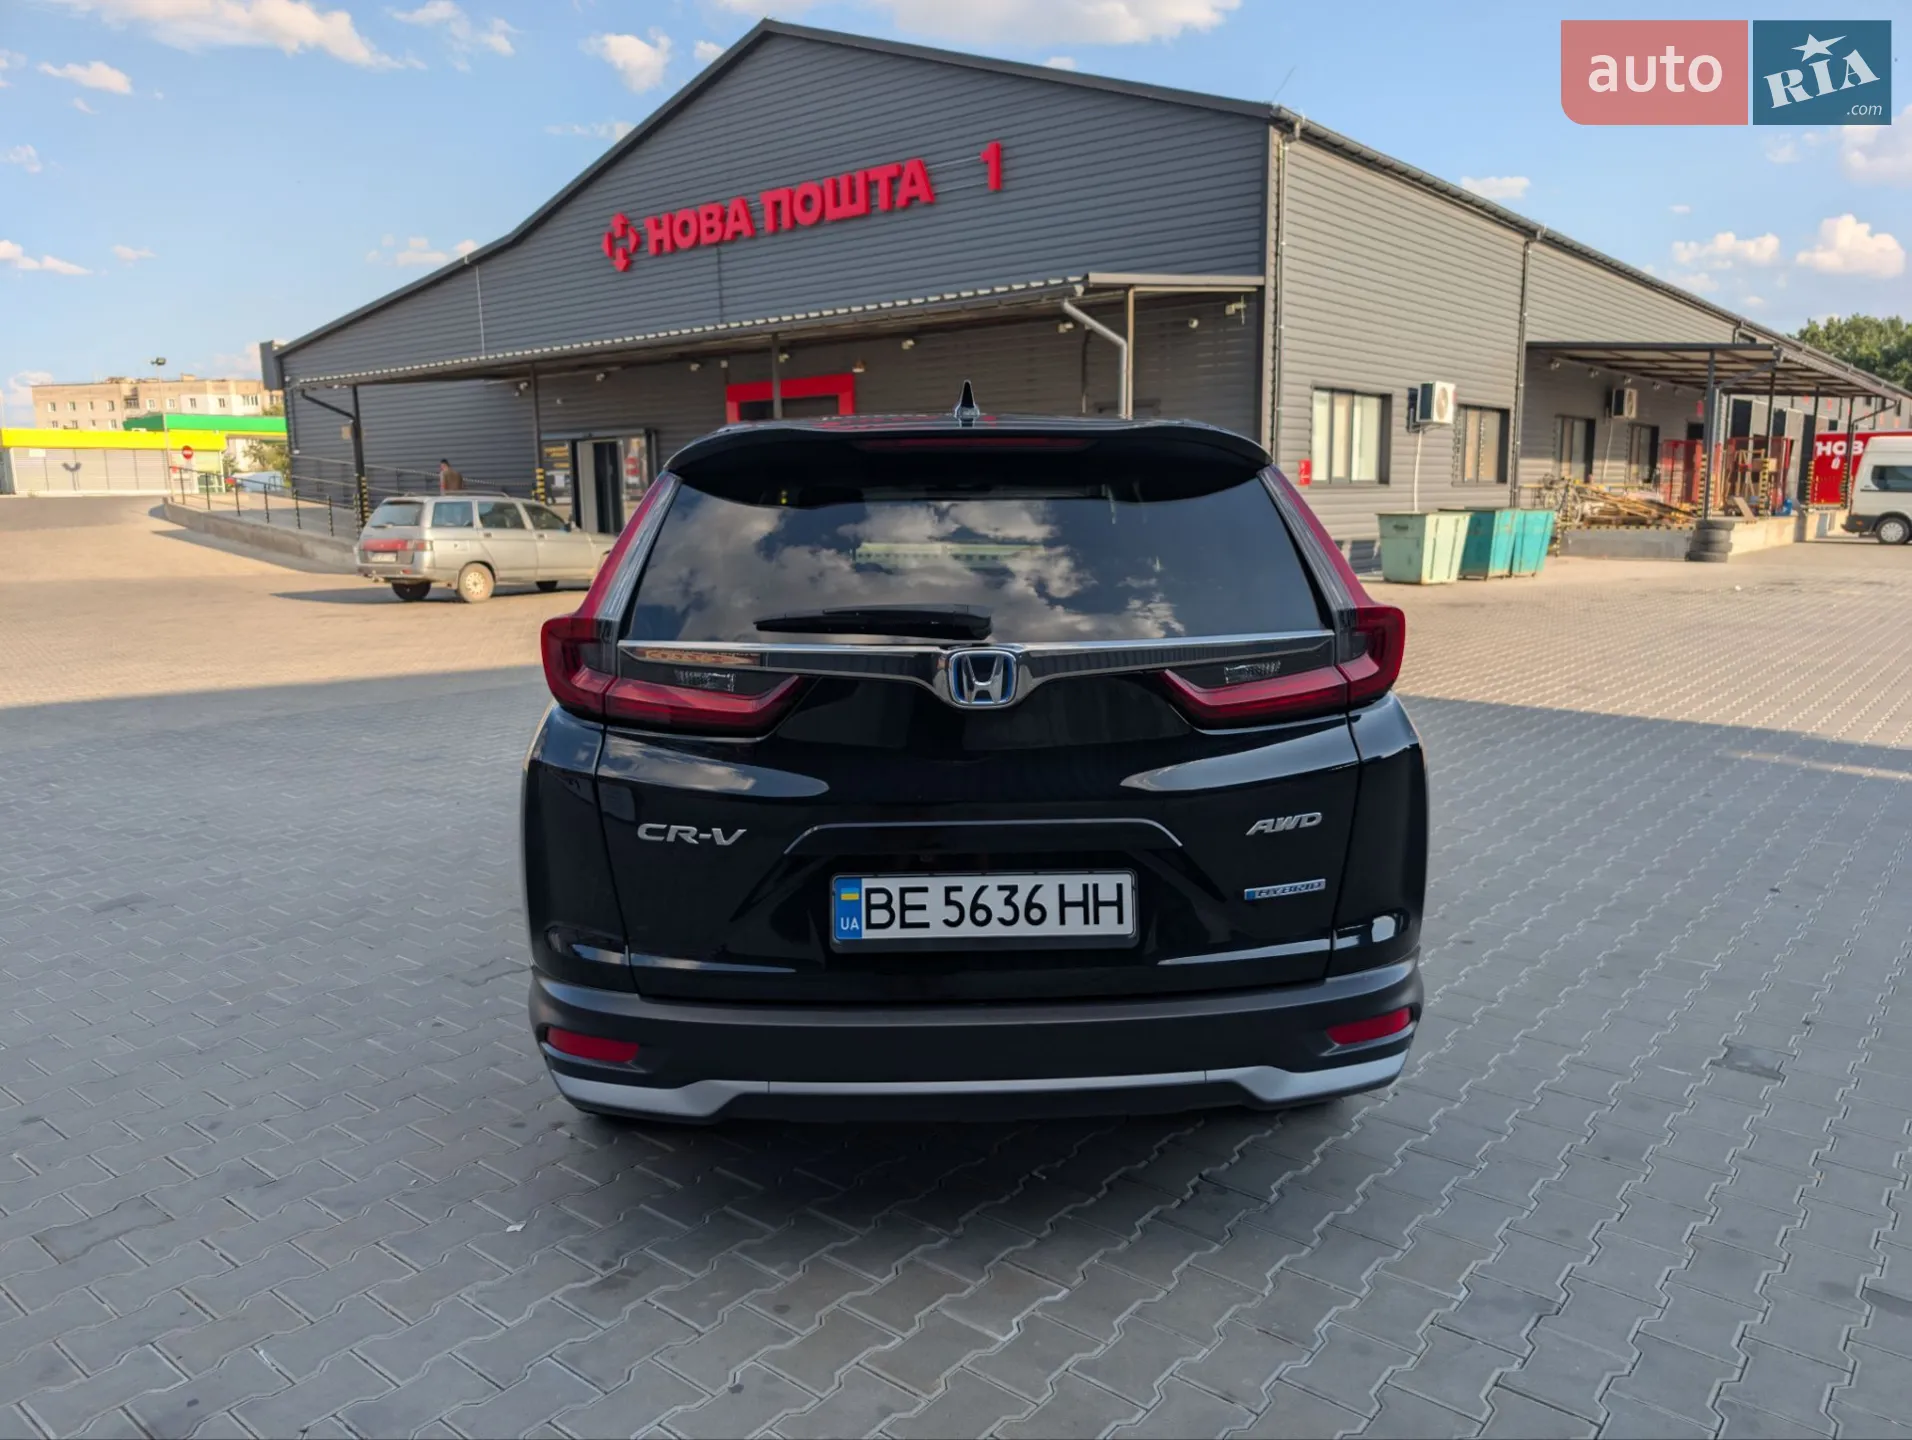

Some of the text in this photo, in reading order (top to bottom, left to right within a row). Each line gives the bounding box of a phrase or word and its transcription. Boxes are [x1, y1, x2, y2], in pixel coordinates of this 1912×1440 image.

[643, 141, 1002, 257] НОВА ПОШТА 1
[637, 823, 748, 846] CR-V
[1246, 812, 1323, 836] AWD
[1257, 881, 1324, 898] HYBRID
[864, 882, 1124, 930] BE 5636 HH
[840, 917, 860, 931] UA
